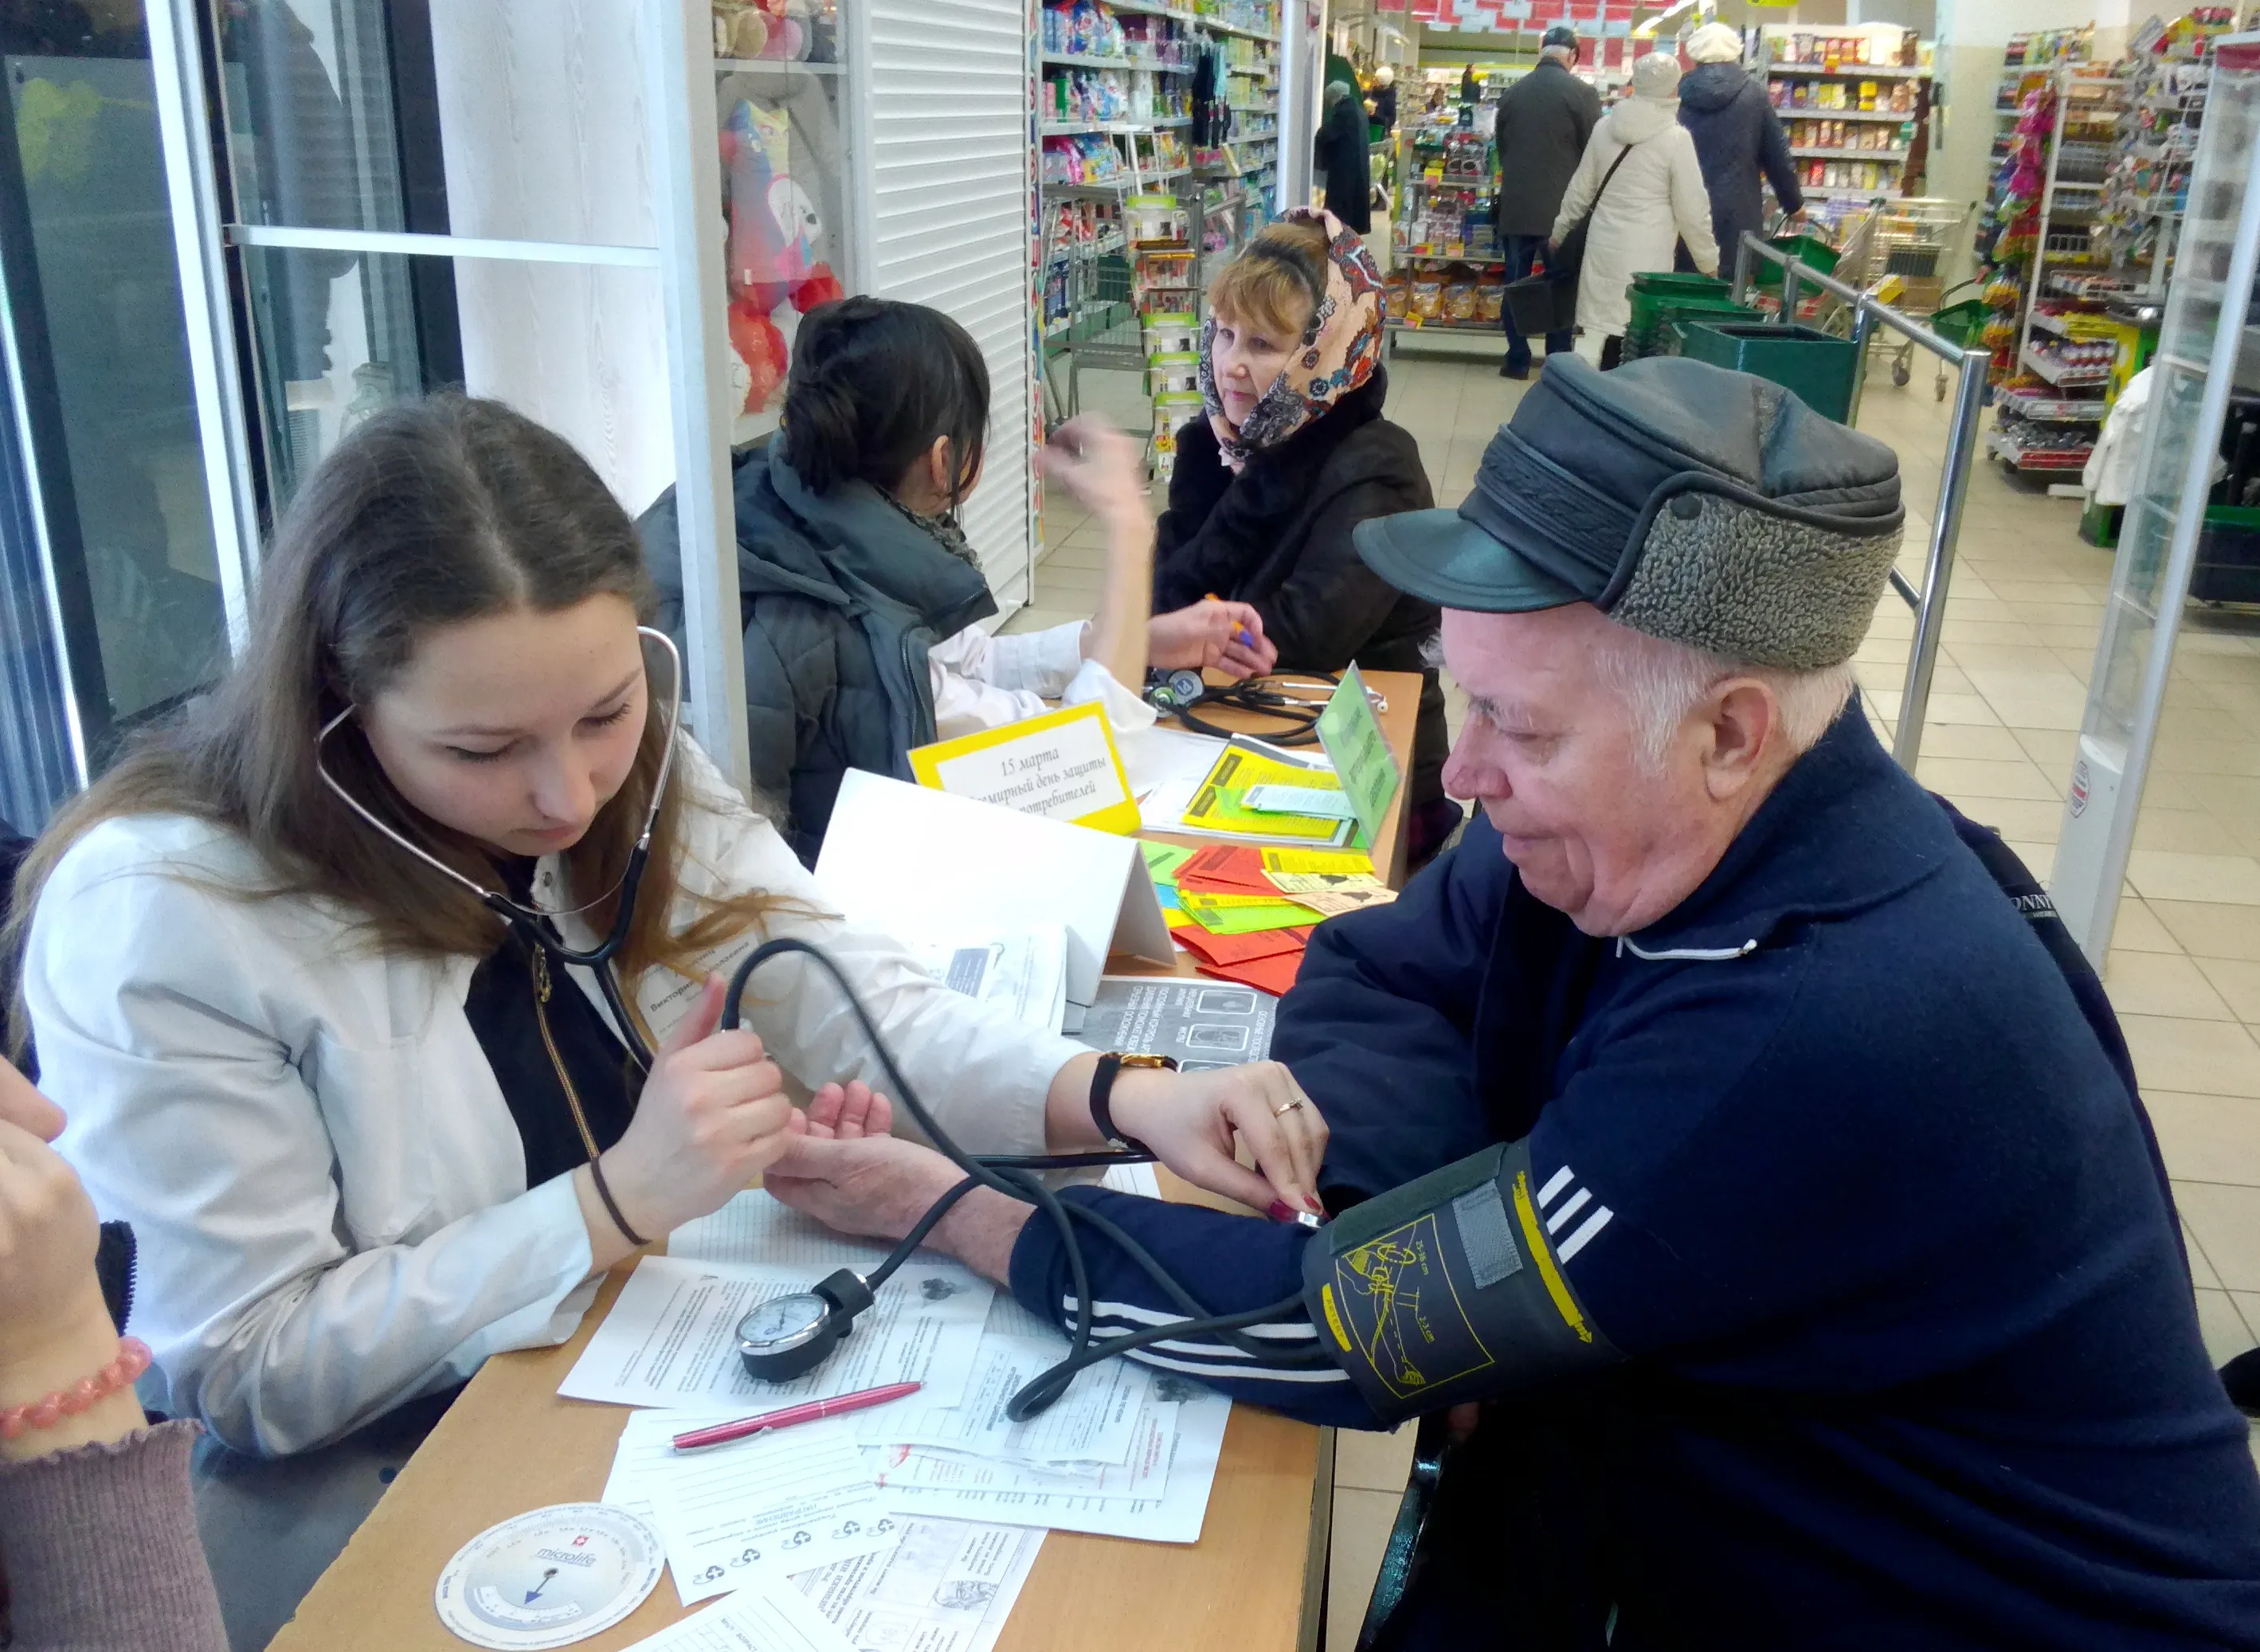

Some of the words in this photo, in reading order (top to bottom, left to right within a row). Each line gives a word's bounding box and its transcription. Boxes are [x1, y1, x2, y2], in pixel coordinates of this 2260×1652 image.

[1001, 758, 1015, 777] 15
[1020, 748, 1059, 771] марта
[1036, 773, 1060, 789] день
[1063, 757, 1106, 780] защиты
[1420, 1262, 1429, 1275] cm
[1326, 1299, 1344, 1337] ARTERY
[535, 1548, 597, 1564] microlife
